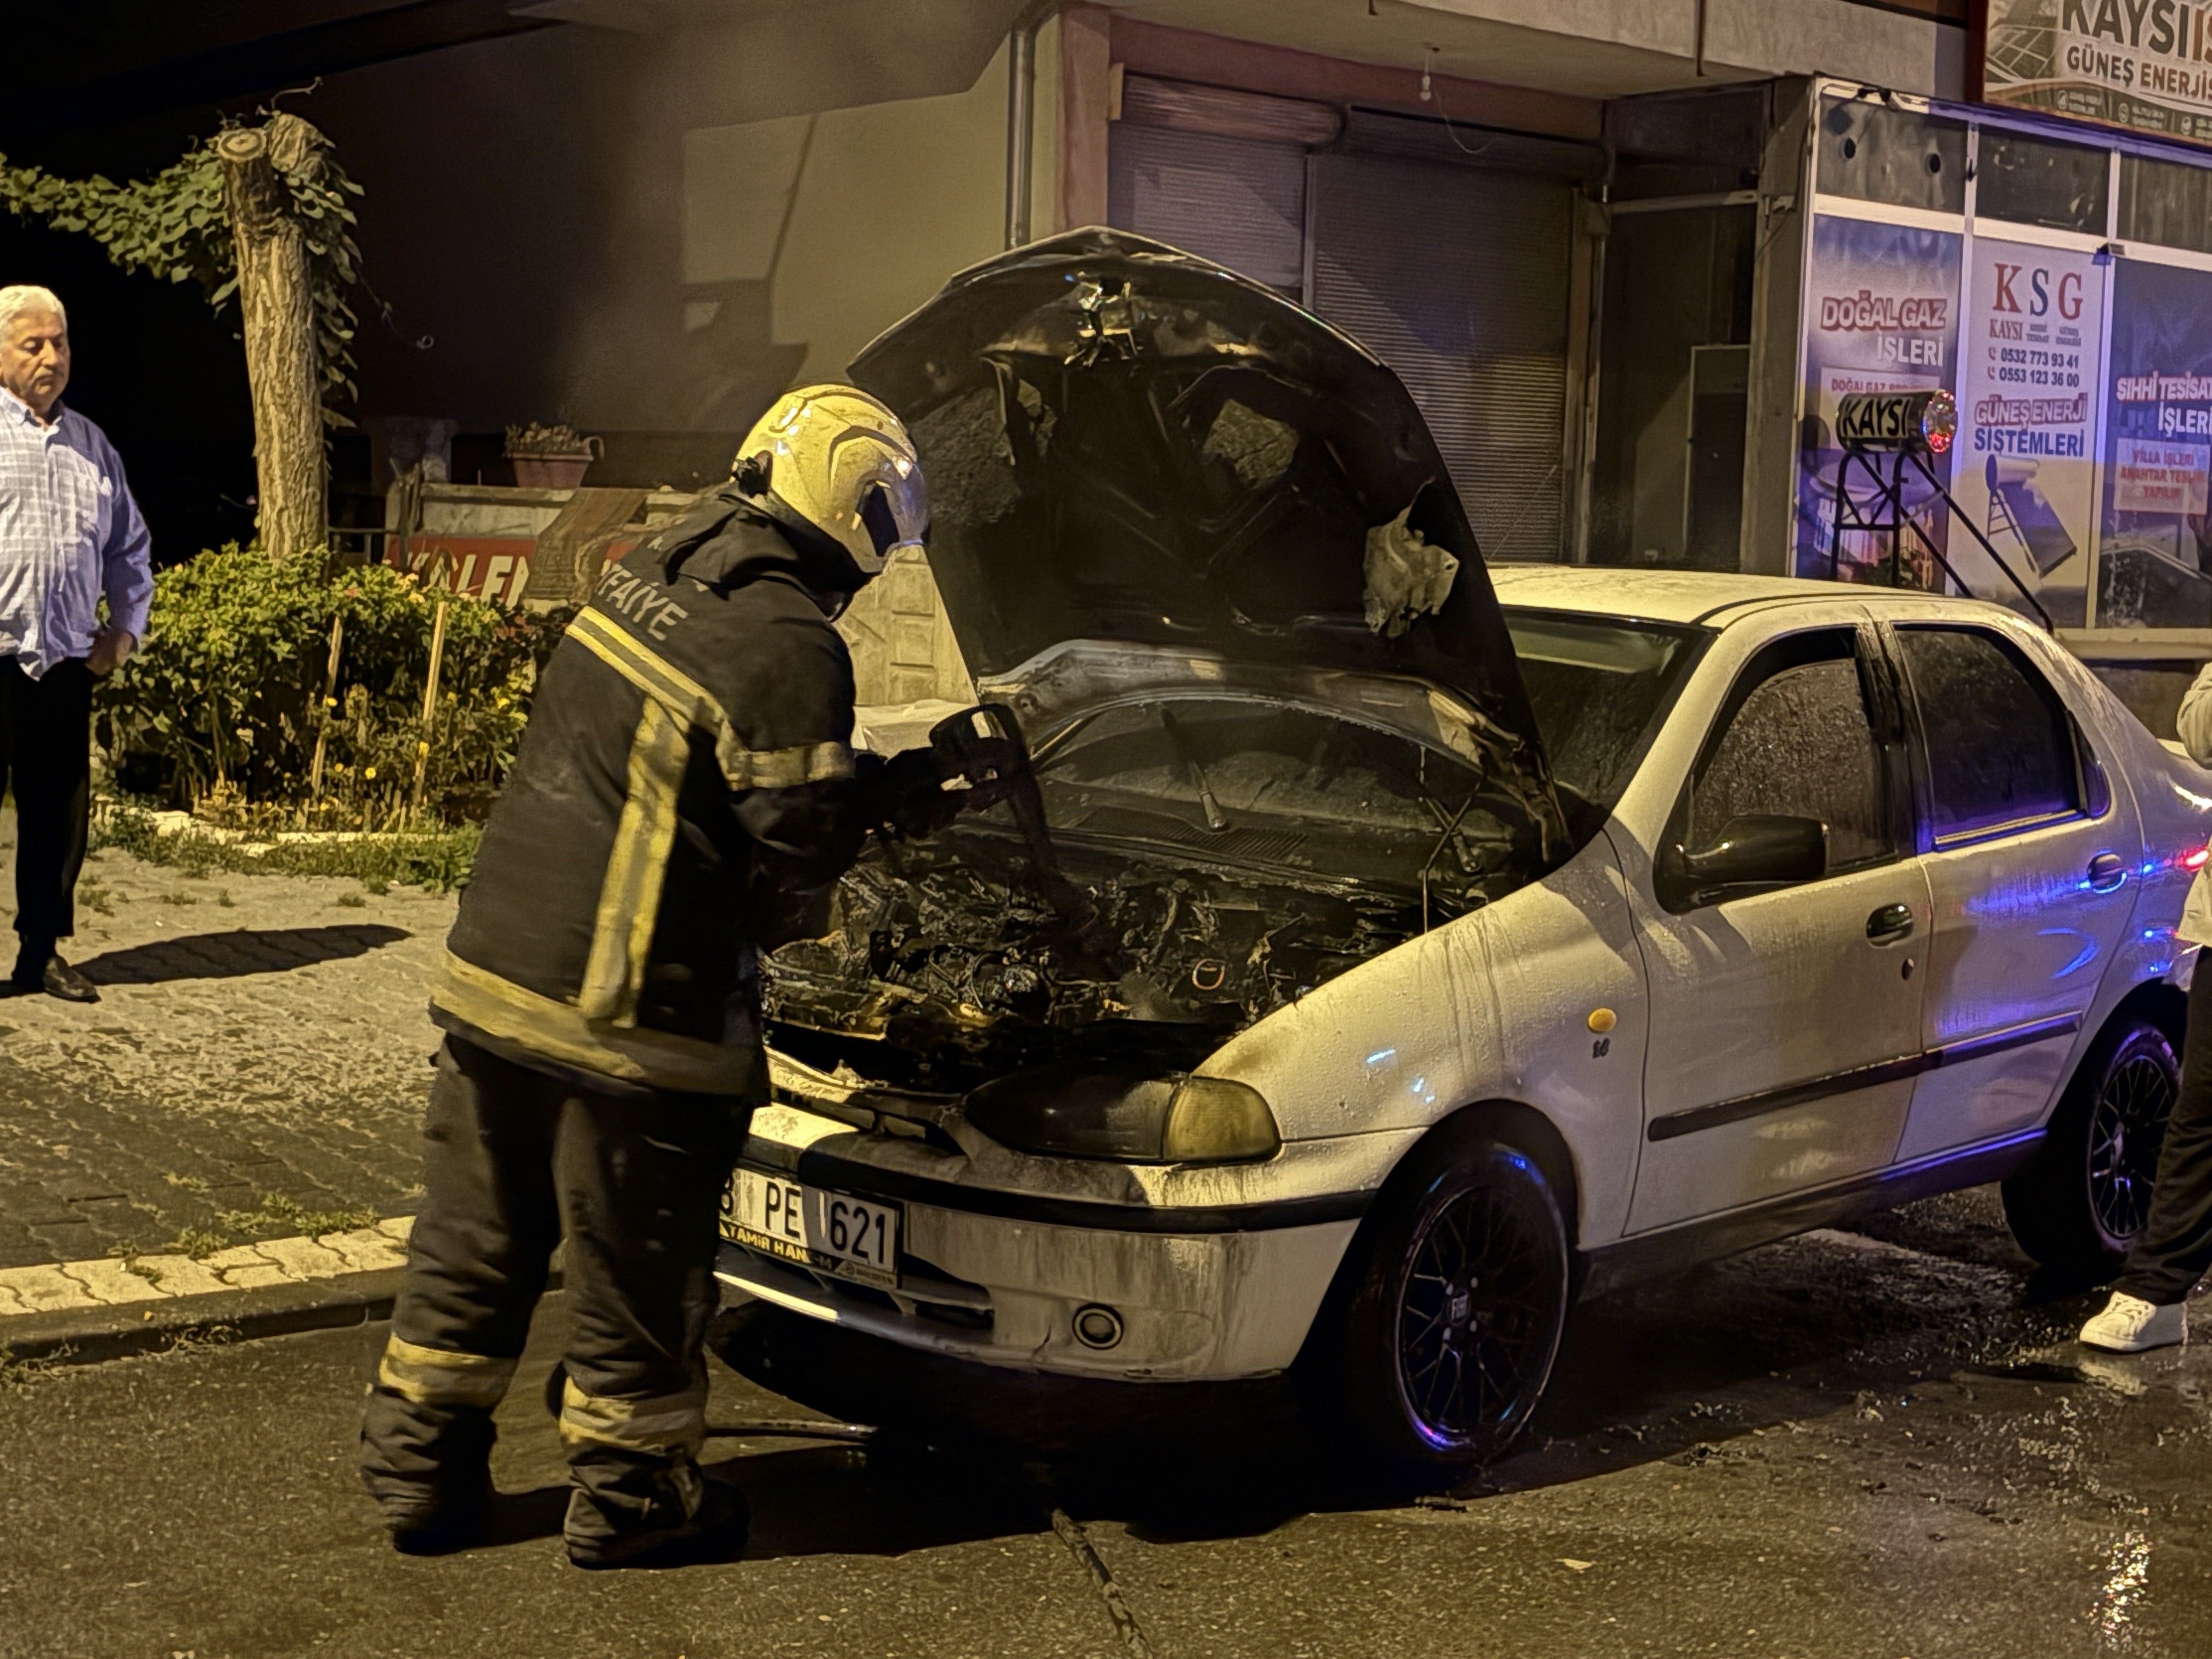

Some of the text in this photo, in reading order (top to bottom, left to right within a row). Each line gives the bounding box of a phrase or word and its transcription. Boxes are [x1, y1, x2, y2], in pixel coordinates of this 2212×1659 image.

[2067, 43, 2134, 87] GÜNEŞ
[1989, 317, 2023, 341] KAYSI
[1877, 331, 1944, 367] İŞLERİ
[2001, 347, 2079, 369] 0532 773 93 41
[1999, 366, 2080, 388] 0553 123 36 00
[1842, 398, 1911, 437] KAYSI
[1975, 393, 2088, 430] GÜNEŞ ENERJİ
[1974, 426, 2085, 458] SİSTEMLERİ
[765, 1180, 802, 1239] PE
[830, 1200, 886, 1265] 621
